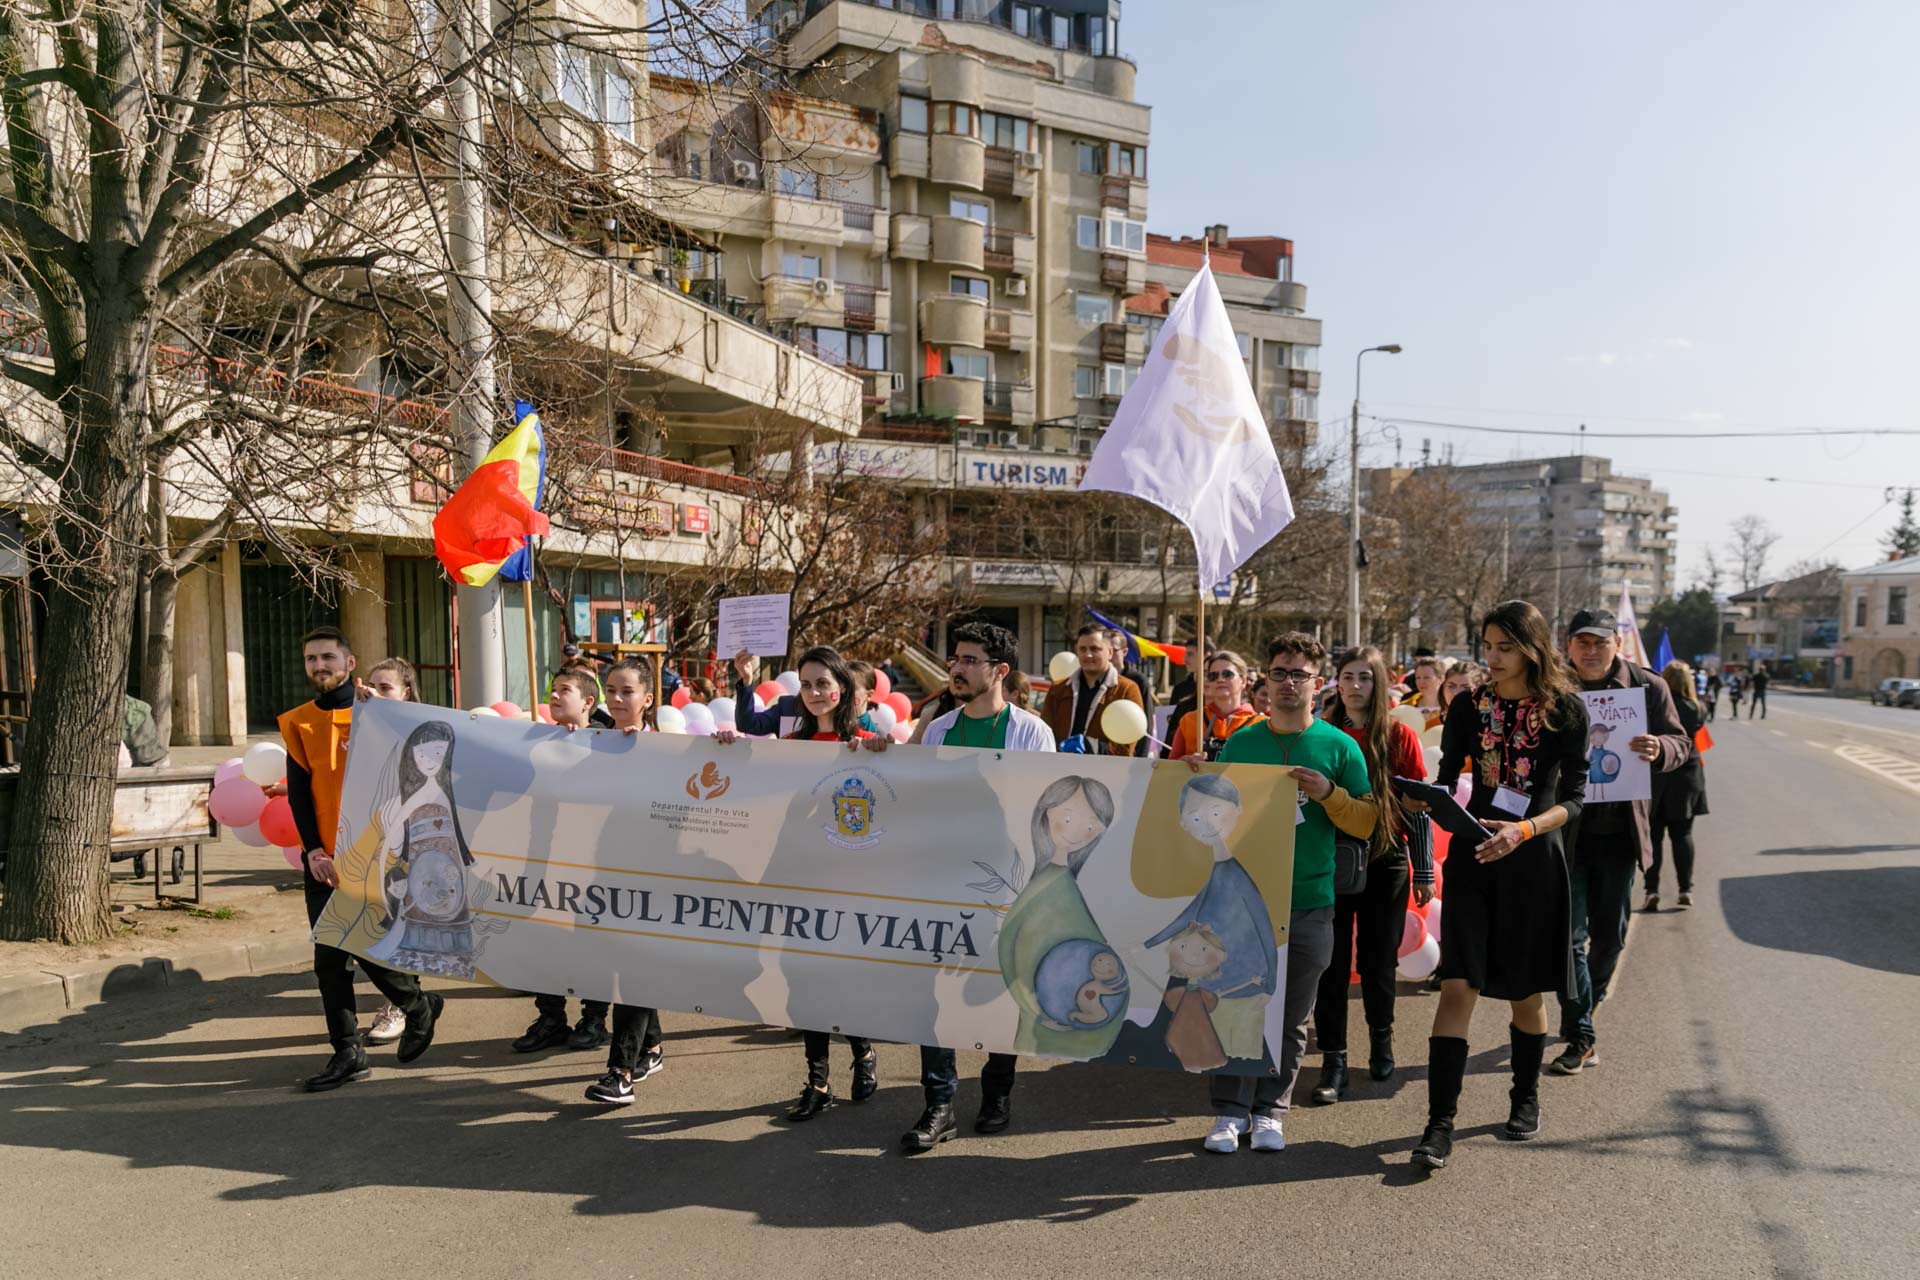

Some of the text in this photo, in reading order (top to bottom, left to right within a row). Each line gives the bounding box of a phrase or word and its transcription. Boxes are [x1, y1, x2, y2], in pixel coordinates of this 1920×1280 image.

[973, 461, 1067, 485] TURISM
[651, 801, 749, 818] Departamentul Pro Vita
[671, 893, 845, 942] PENTRU
